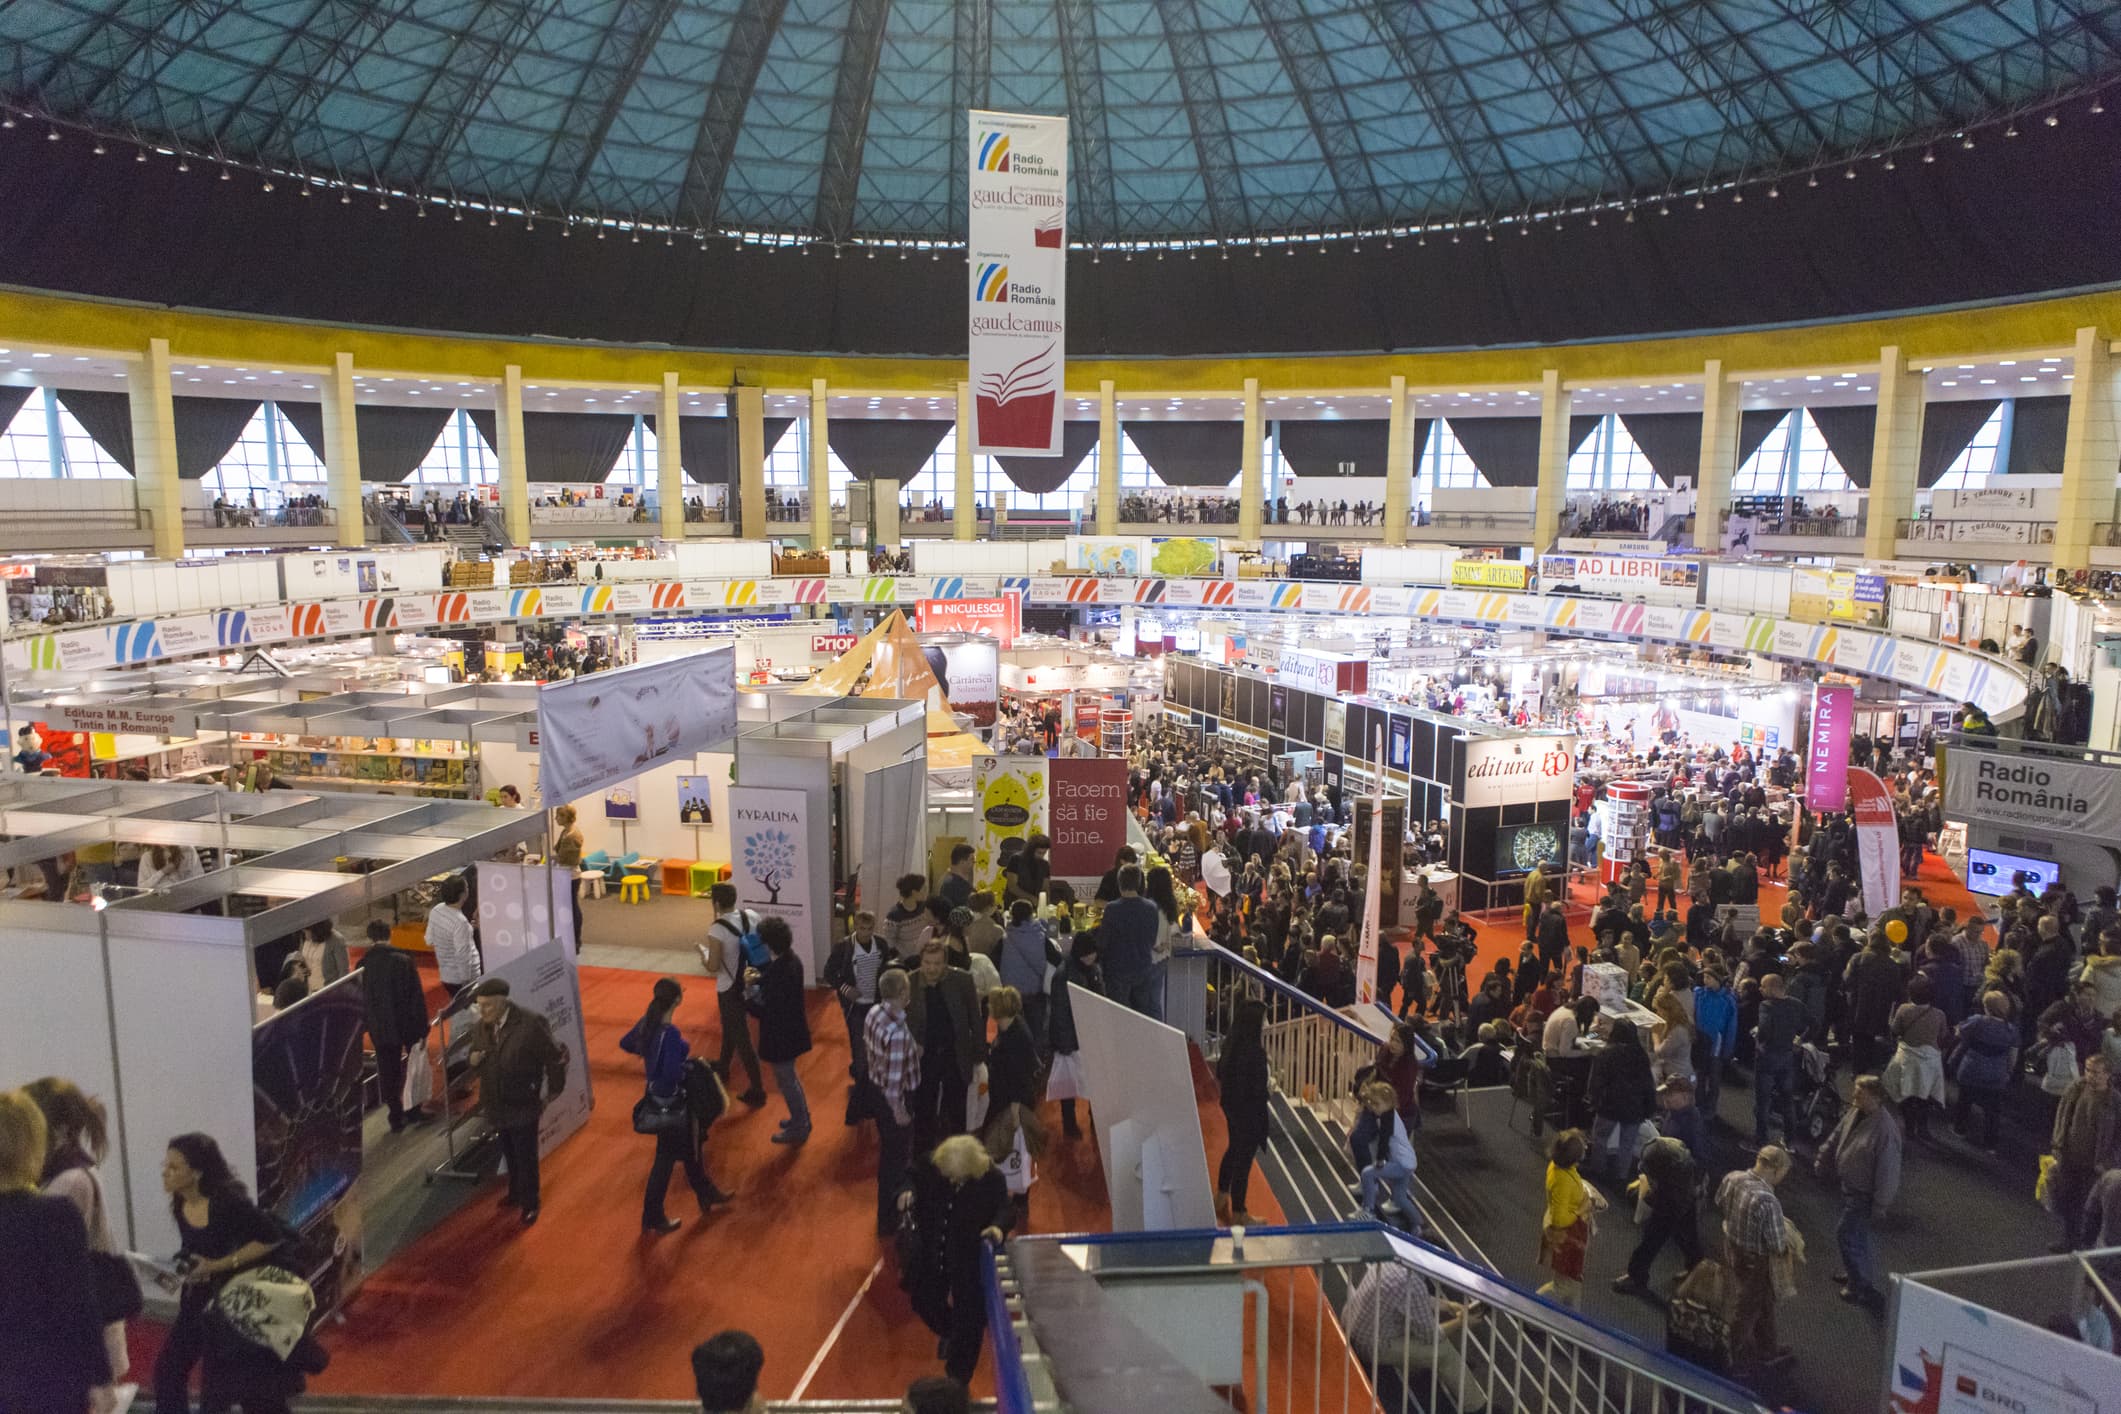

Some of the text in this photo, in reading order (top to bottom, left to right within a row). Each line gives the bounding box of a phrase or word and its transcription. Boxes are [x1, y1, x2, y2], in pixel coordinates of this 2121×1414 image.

[1013, 153, 1044, 164] Radio
[1013, 164, 1059, 177] România
[1011, 283, 1041, 294] Radio
[1011, 294, 1056, 306] România
[1486, 567, 1523, 585] ARTEMIS
[1578, 559, 1659, 577] AD LIBRI
[944, 604, 1005, 614] NICULESCU
[814, 636, 855, 650] Prior
[1280, 656, 1315, 678] editura
[64, 707, 175, 724] Editura M.M. Europe
[72, 719, 169, 734] Tintin in Romania
[1815, 692, 1834, 773] NEMIRA
[1467, 756, 1535, 779] editura
[1978, 760, 2050, 786] Radio
[1056, 780, 1121, 798] Facem
[1976, 782, 2088, 814] România
[737, 808, 800, 823] KYRALINA
[1084, 804, 1108, 821] fie
[1056, 827, 1104, 845] bine.
